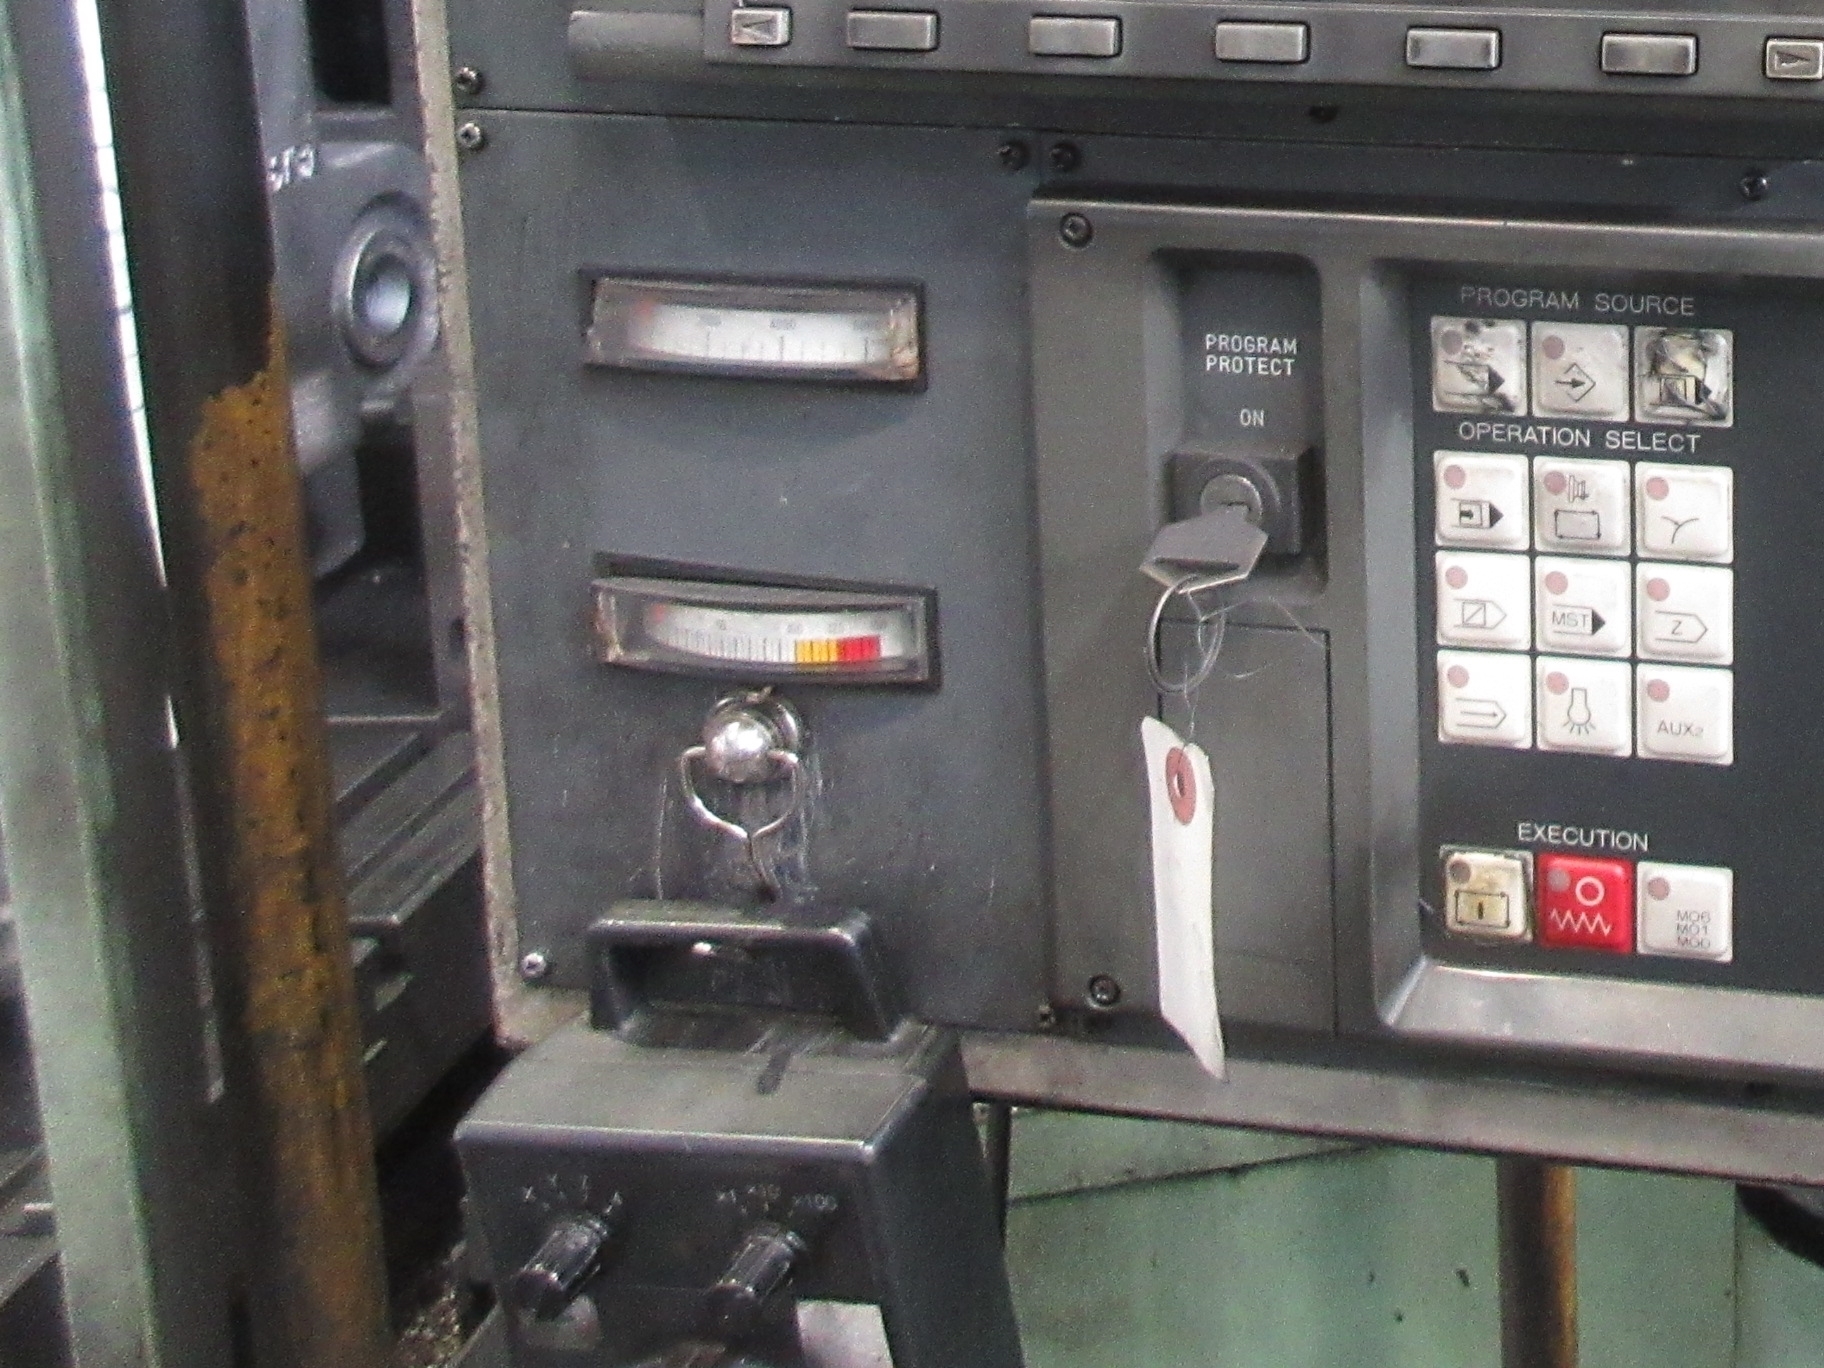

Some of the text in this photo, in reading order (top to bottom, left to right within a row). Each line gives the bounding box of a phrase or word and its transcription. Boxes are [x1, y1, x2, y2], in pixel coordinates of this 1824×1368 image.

[1460, 285, 1696, 316] PROGRAM SOURCE
[1204, 333, 1299, 356] PROGRAM
[1205, 354, 1296, 377] PROTECT
[1239, 408, 1266, 428] ON
[1458, 421, 1702, 454] OPERATION SELECT
[1550, 609, 1592, 631] MST
[1516, 822, 1651, 853] EXECUTION
